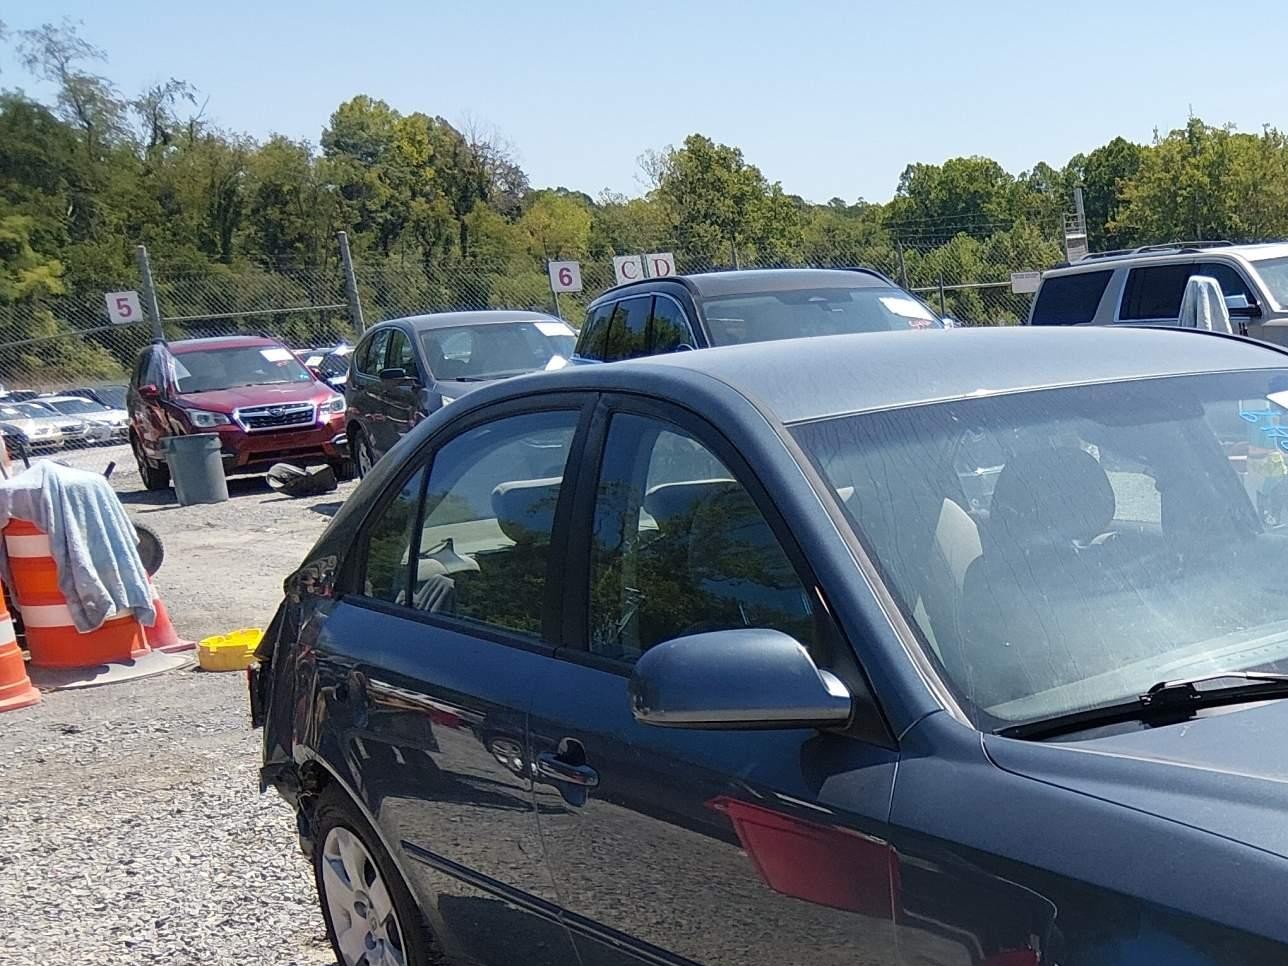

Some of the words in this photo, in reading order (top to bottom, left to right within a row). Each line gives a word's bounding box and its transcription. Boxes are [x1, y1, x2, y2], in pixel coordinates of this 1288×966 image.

[558, 267, 573, 287] 6
[621, 260, 638, 280] C
[652, 258, 671, 278] D
[116, 297, 132, 317] 5
